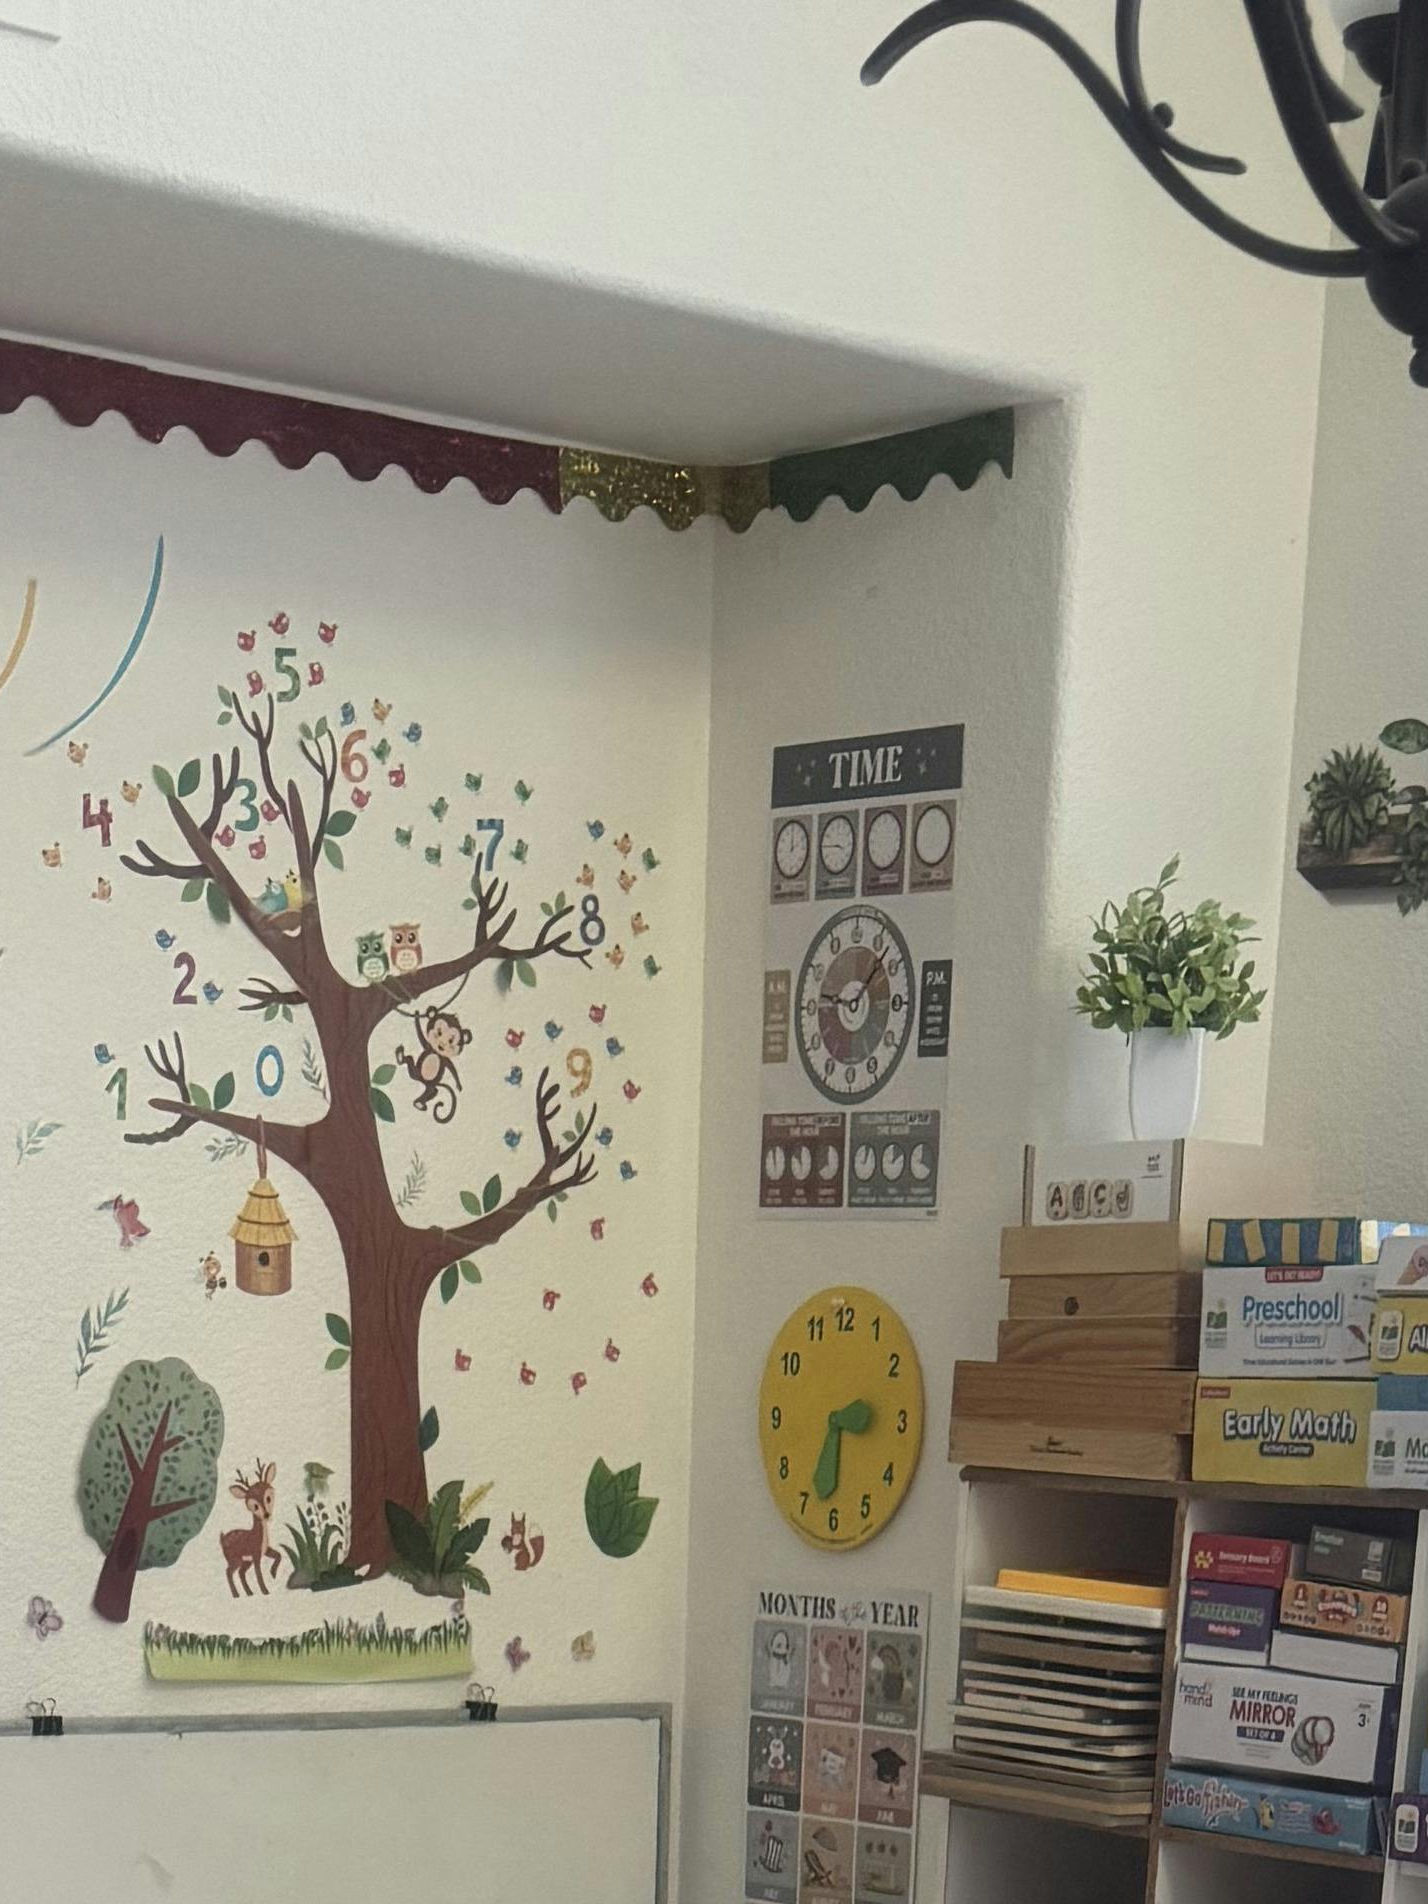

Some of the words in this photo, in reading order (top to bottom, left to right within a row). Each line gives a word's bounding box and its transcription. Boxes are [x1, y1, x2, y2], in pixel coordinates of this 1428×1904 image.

[273, 647, 300, 703] 5
[829, 745, 903, 790] TIME
[81, 793, 111, 846] 4
[256, 1045, 284, 1096] 0
[835, 1307, 854, 1333] 12
[1243, 1293, 1341, 1323] Preschool
[781, 1352, 801, 1377] 10
[1224, 1408, 1283, 1441] Early
[1290, 1411, 1355, 1442] Math
[759, 1592, 837, 1622] MONTHS
[870, 1600, 919, 1628] YEAR
[1229, 1698, 1295, 1728] MIRROR
